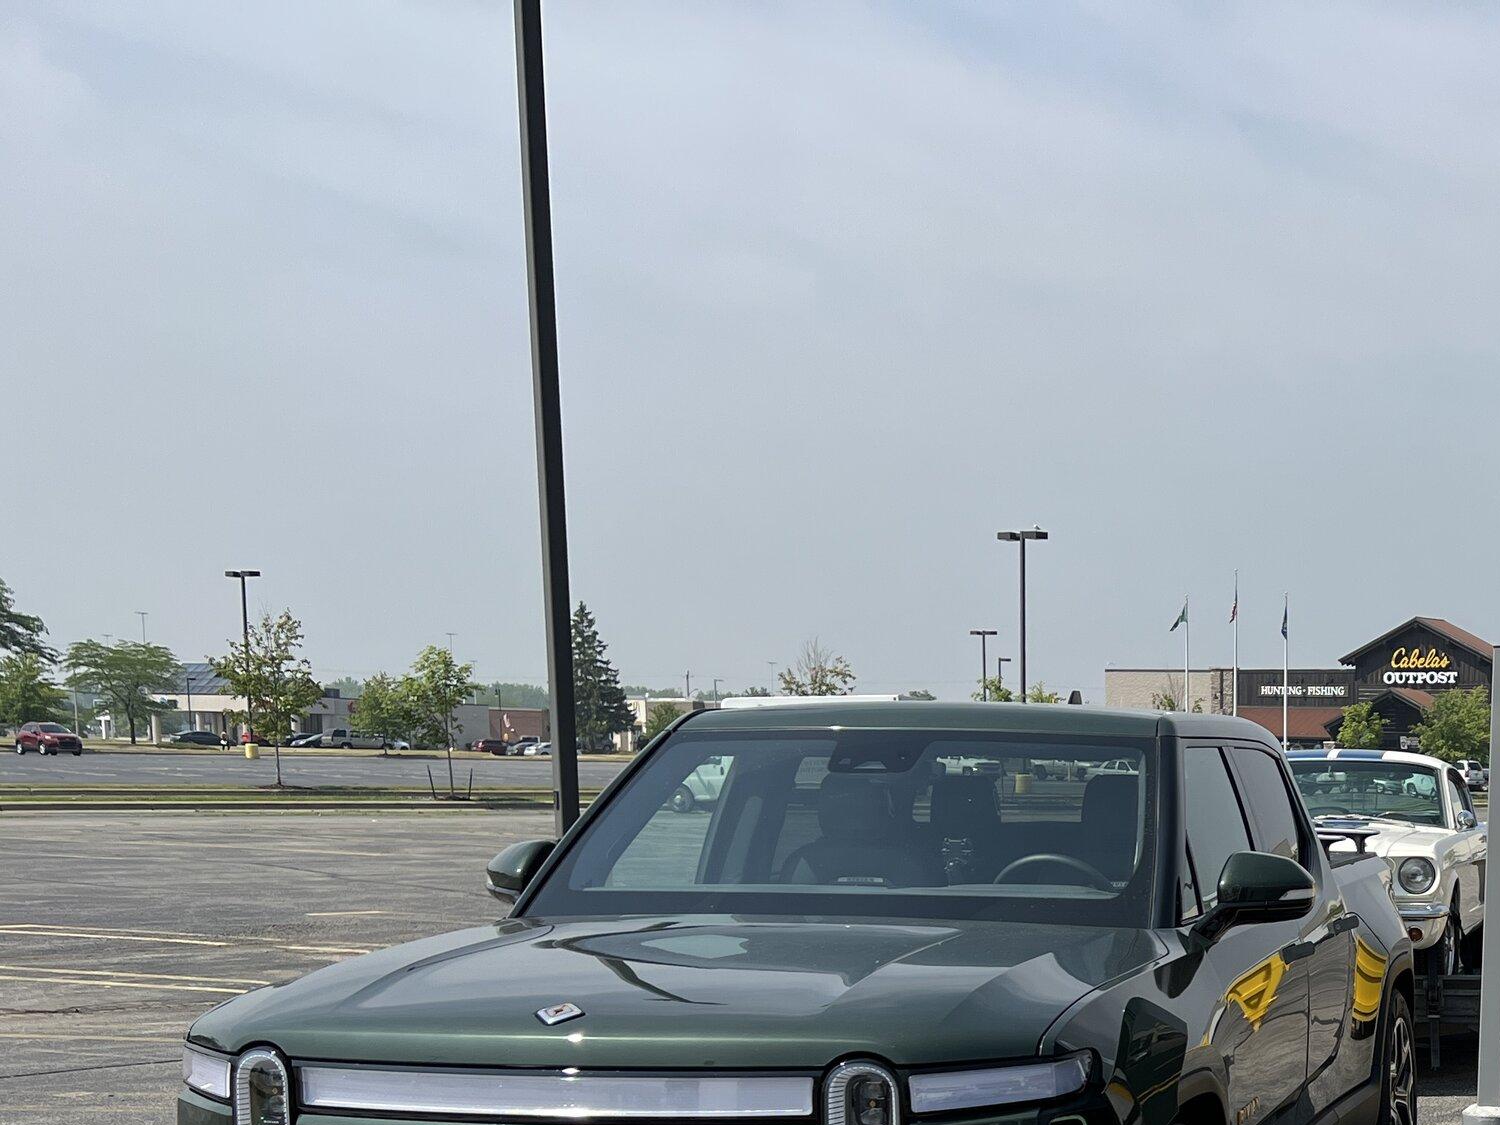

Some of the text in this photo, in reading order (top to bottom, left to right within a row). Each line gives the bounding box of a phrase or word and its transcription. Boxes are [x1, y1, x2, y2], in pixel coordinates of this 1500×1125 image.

[1390, 647, 1450, 669] Cabela's
[1382, 671, 1458, 685] OUTPOST
[1307, 685, 1345, 696] FISHING
